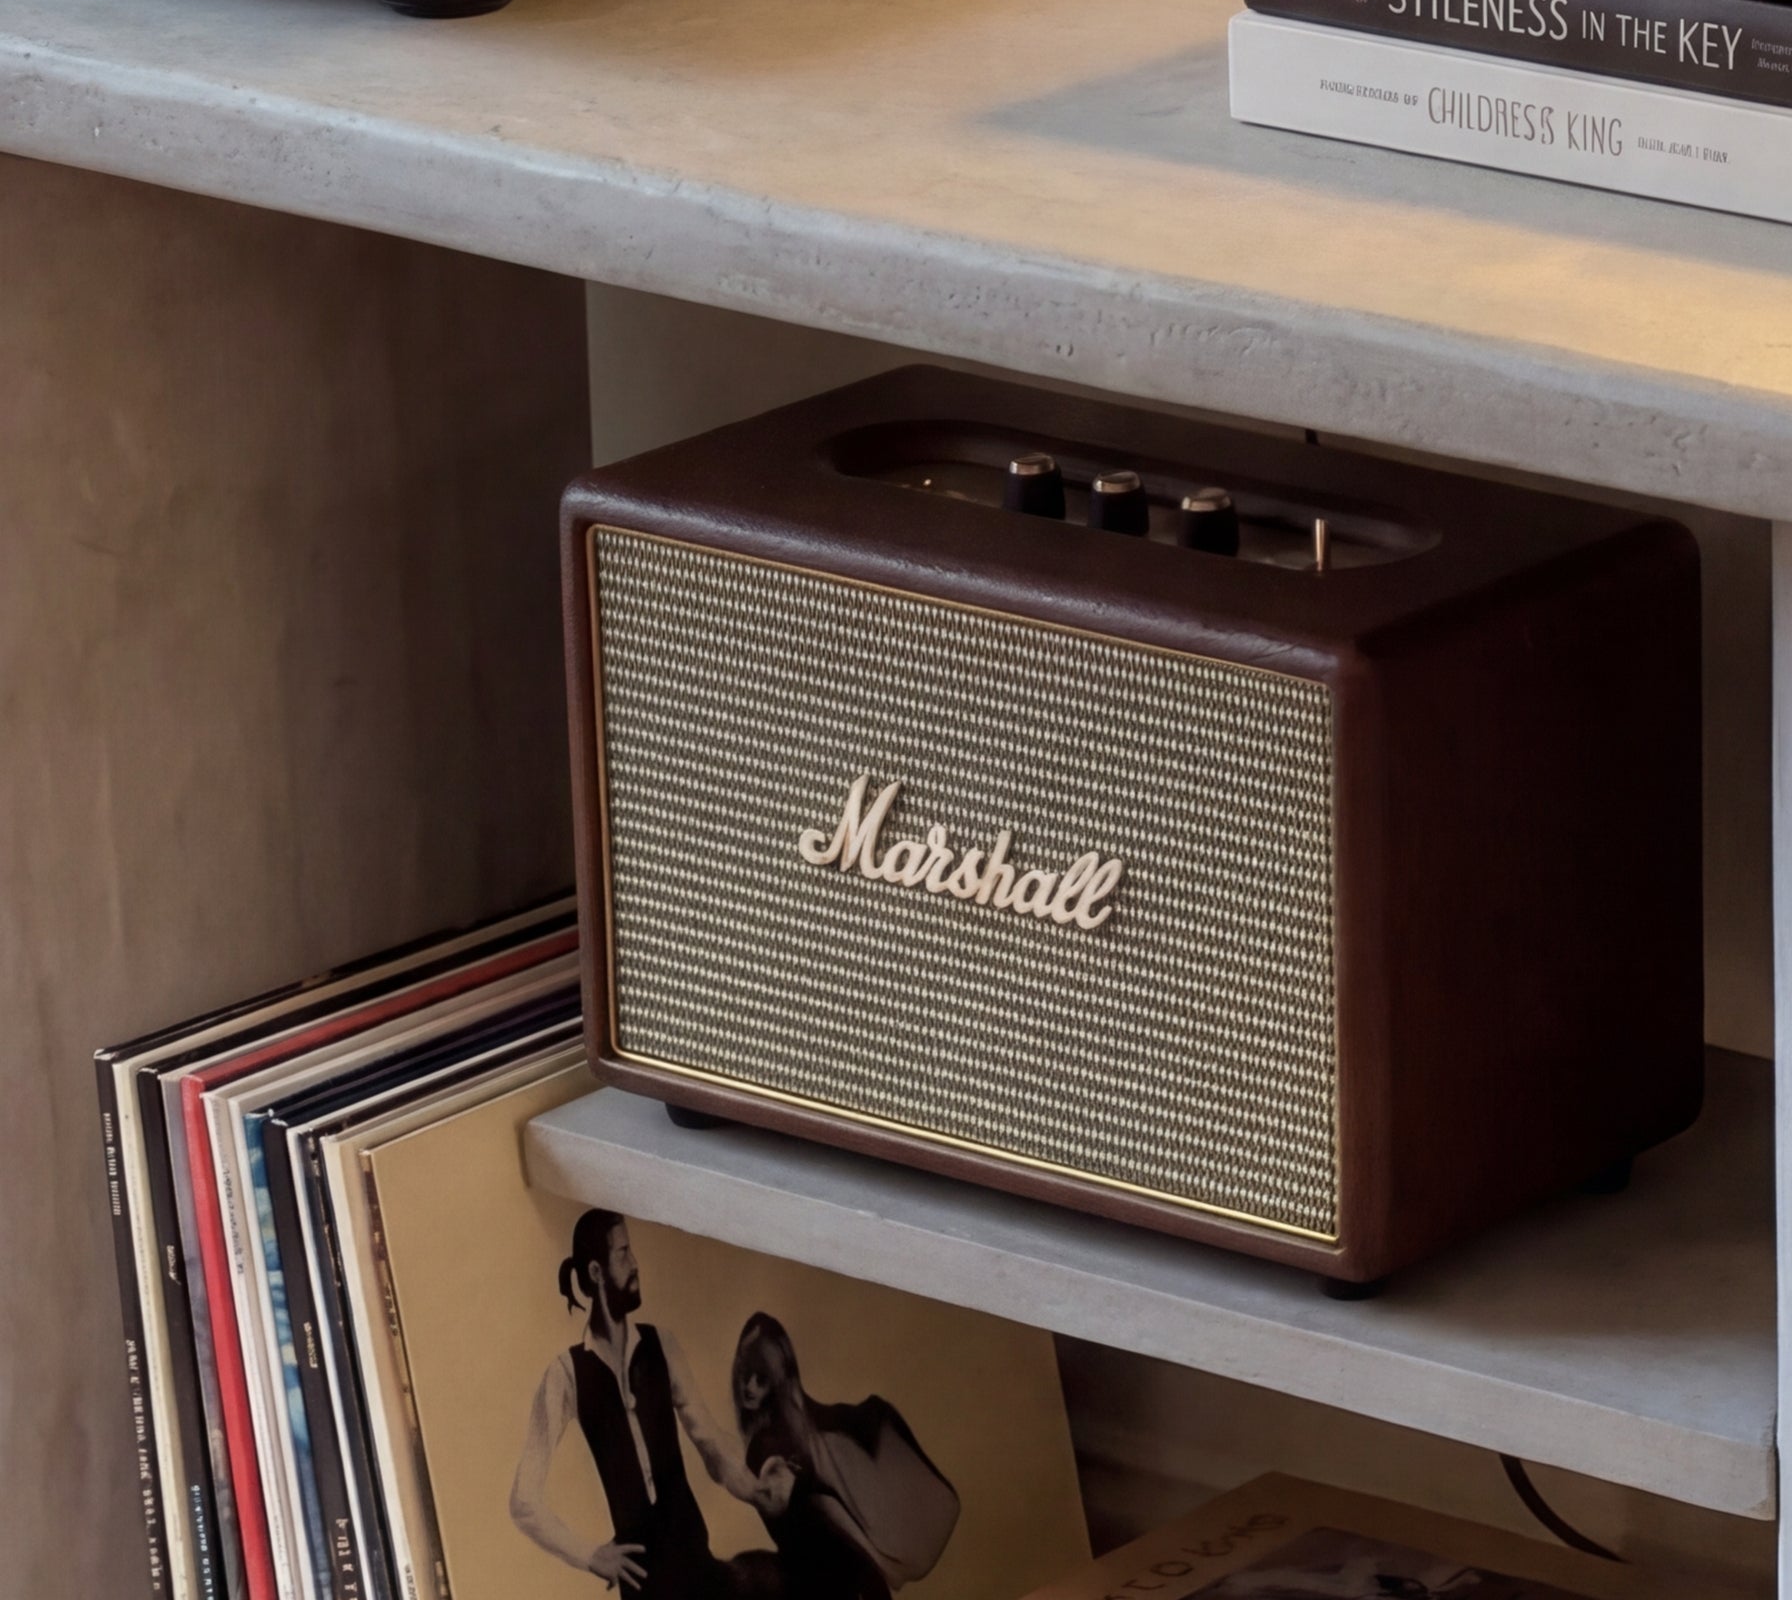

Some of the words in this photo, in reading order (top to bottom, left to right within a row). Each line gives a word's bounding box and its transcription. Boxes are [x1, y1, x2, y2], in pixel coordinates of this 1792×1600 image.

[1582, 9, 1606, 42] IN
[1615, 13, 1668, 55] THE
[1678, 17, 1743, 71] KEY
[1567, 110, 1623, 157] KING
[799, 773, 1123, 930] Marshall
